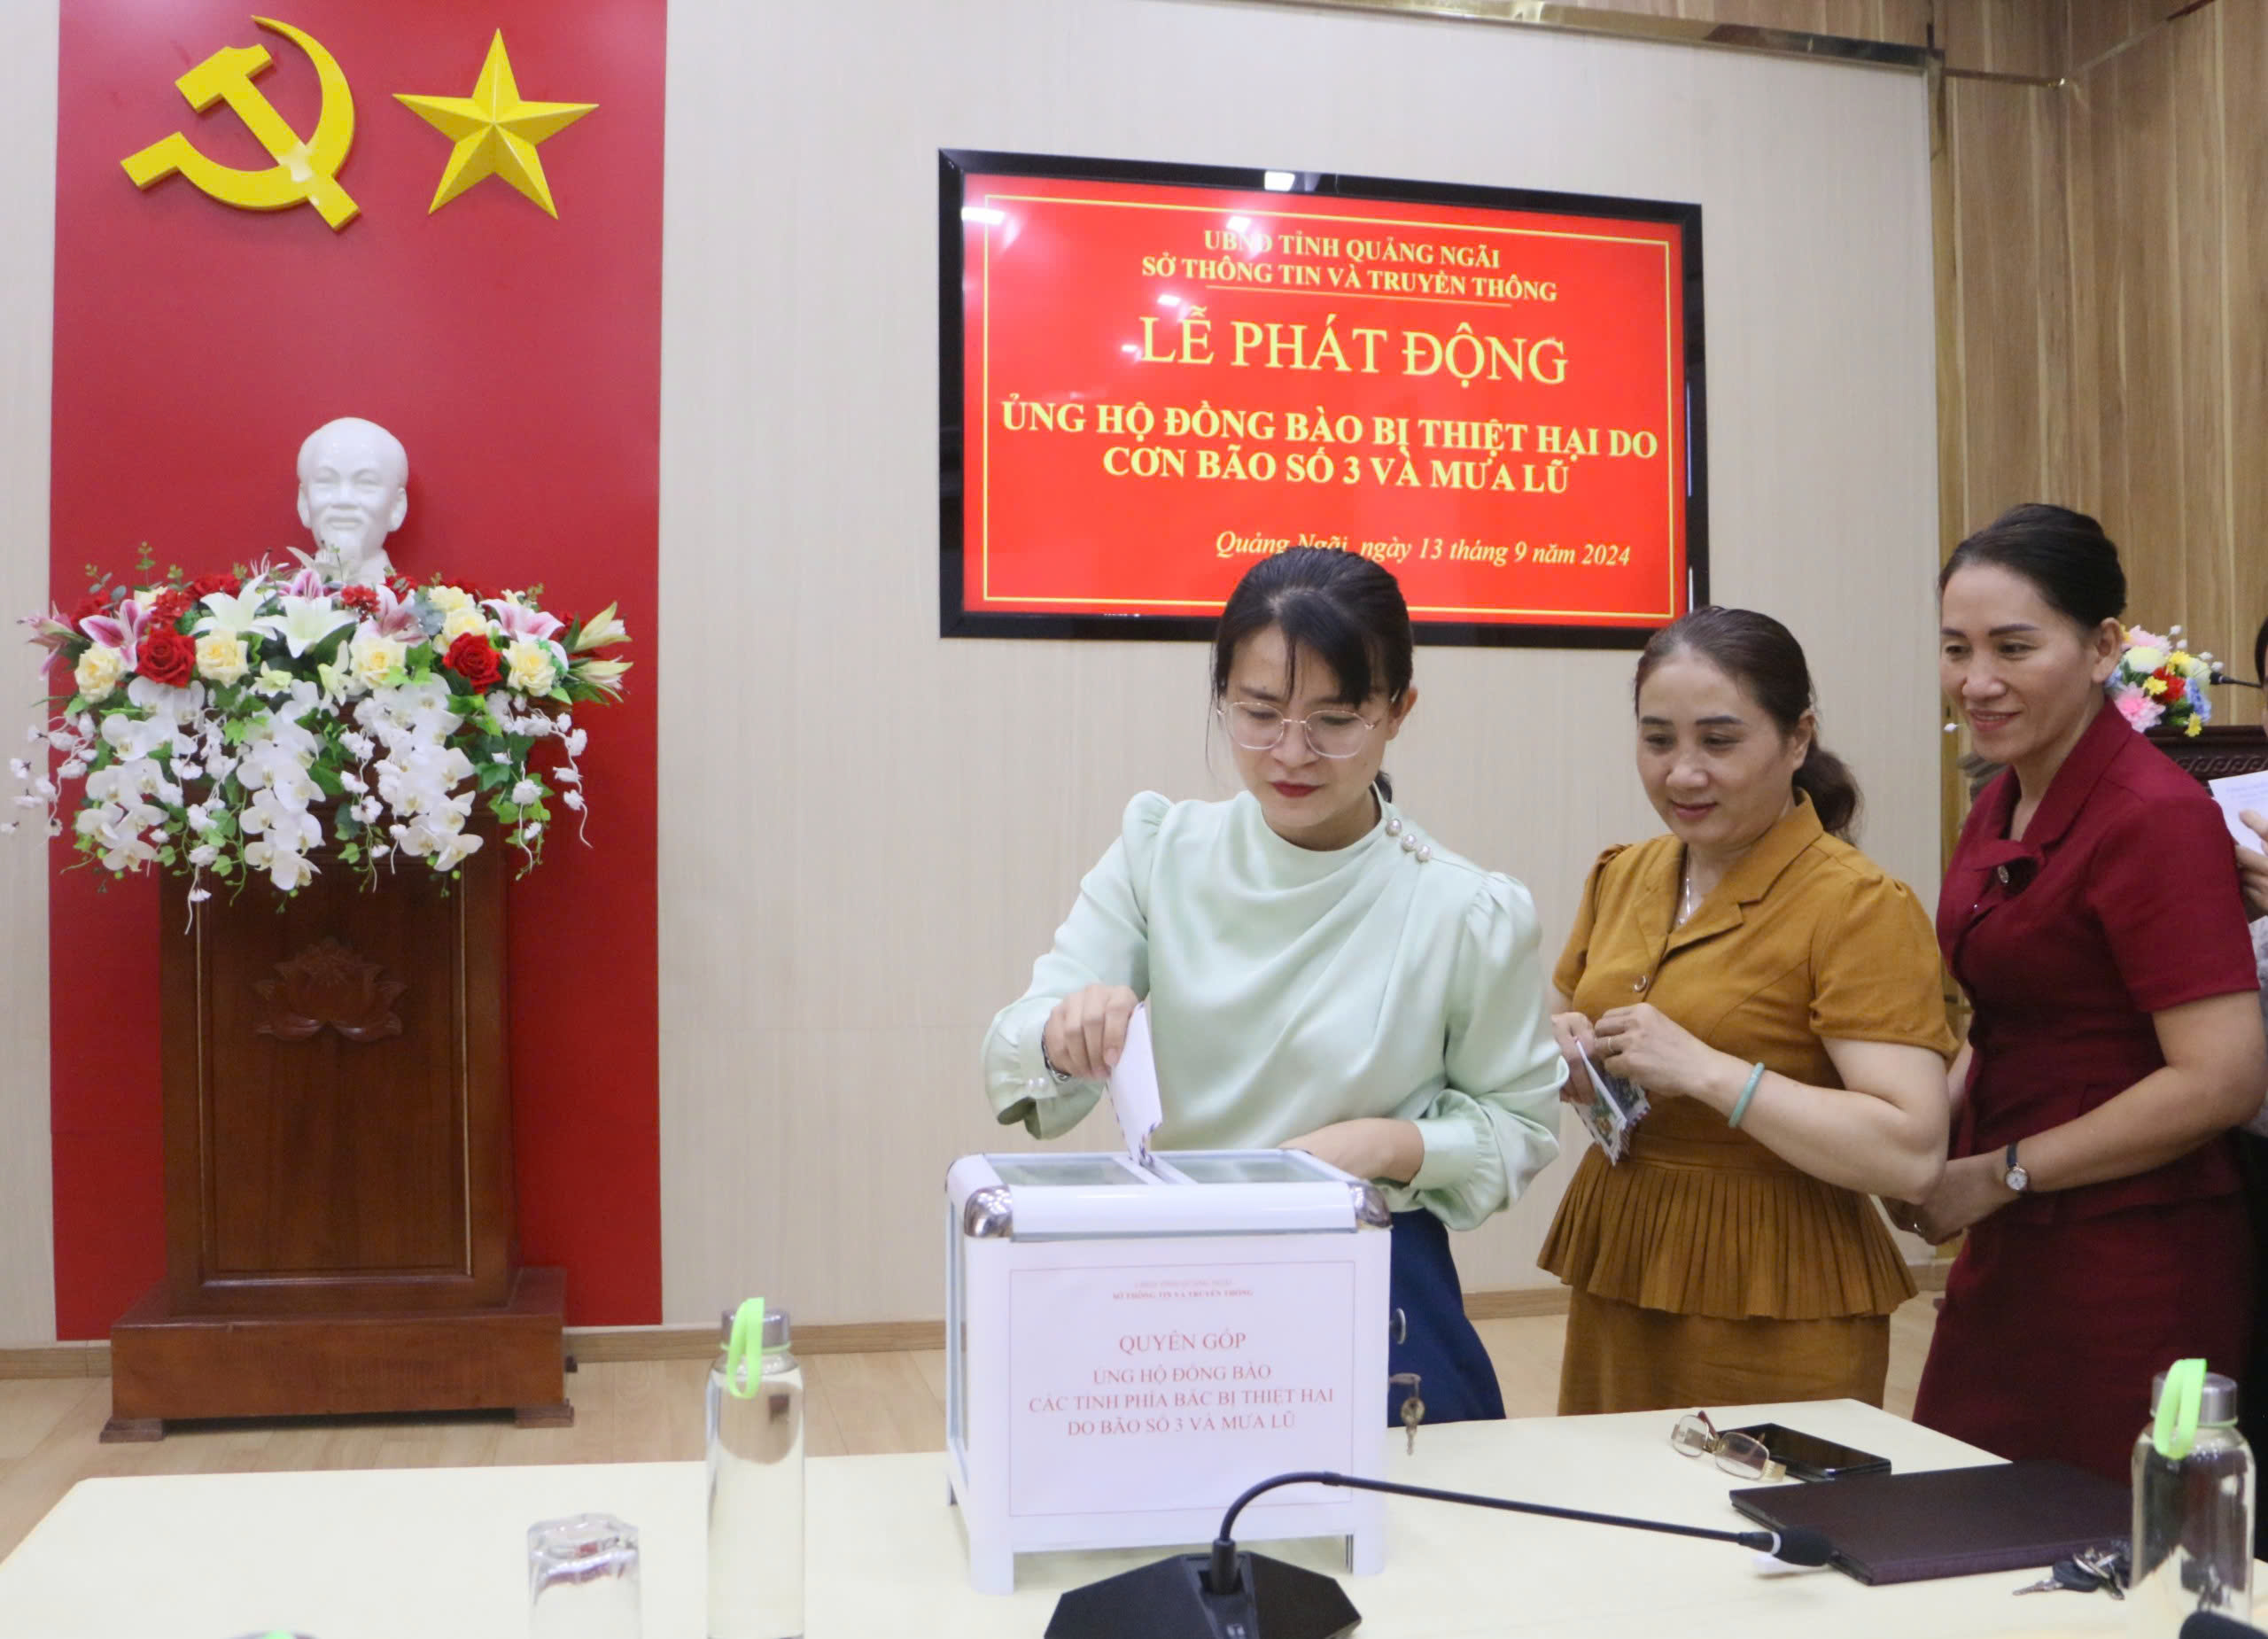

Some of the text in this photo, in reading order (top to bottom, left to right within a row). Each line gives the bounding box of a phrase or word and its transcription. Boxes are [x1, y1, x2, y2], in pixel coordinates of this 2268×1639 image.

[1204, 230, 1500, 268] UBND TỈNH QUẢNG NGÃI
[1142, 252, 1557, 301] SỞ THÔNG TIN VÀ TRUYỀN THÔNG
[1140, 305, 1569, 388] LỄ PHÁT ĐỘNG
[1002, 392, 1658, 462] ỦNG HỘ ĐỒNG BÀO BỊ THIỆT HẠI DO
[1103, 444, 1569, 493] CƠN BÃO SỐ 3 VÀ MƯA LŨ
[1216, 531, 1290, 558] Quảng
[1361, 536, 1411, 563] ngày
[1420, 538, 1443, 560] 13
[1449, 540, 1509, 567] tháng
[1514, 541, 1527, 562] 9
[1533, 544, 1575, 564] năm
[1581, 544, 1630, 566] 2024
[1119, 1330, 1196, 1355] QUYÊN
[1140, 1363, 1168, 1385] HỘ
[1232, 1361, 1271, 1380] BÀO
[1125, 1389, 1169, 1409] PHÍA
[1218, 1390, 1236, 1409] BỊ
[1068, 1419, 1095, 1436] DO
[1100, 1415, 1141, 1435] BÃO
[1176, 1418, 1184, 1433] 3
[1190, 1412, 1216, 1432] VÀ
[1222, 1413, 1265, 1431] MƯA
[1270, 1410, 1296, 1428] LŨ
